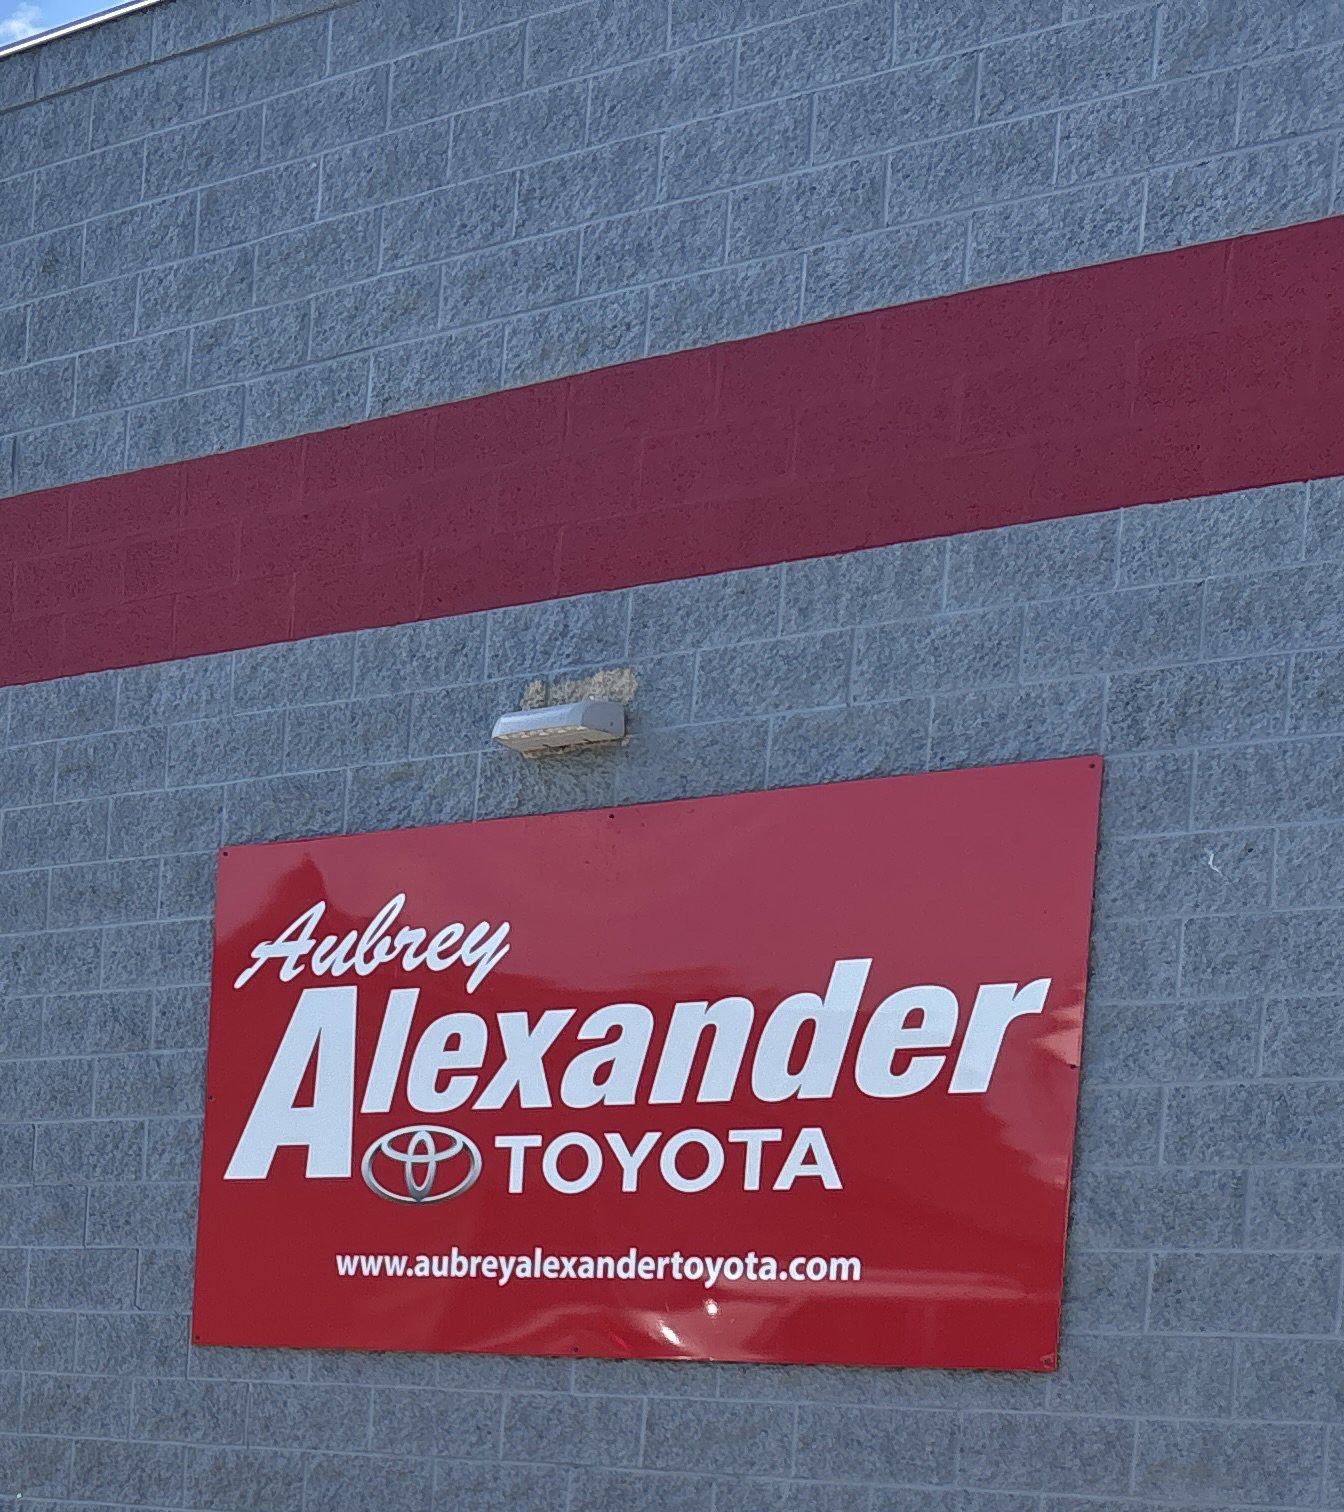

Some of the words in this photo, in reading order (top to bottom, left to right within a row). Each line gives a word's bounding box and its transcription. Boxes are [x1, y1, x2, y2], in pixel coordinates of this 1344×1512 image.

[233, 893, 511, 994] Aubrey
[223, 957, 1052, 1180] Alexander
[494, 1127, 843, 1195] TOYOTA
[335, 1247, 861, 1289] www.aubreyalexandertoyota.com
